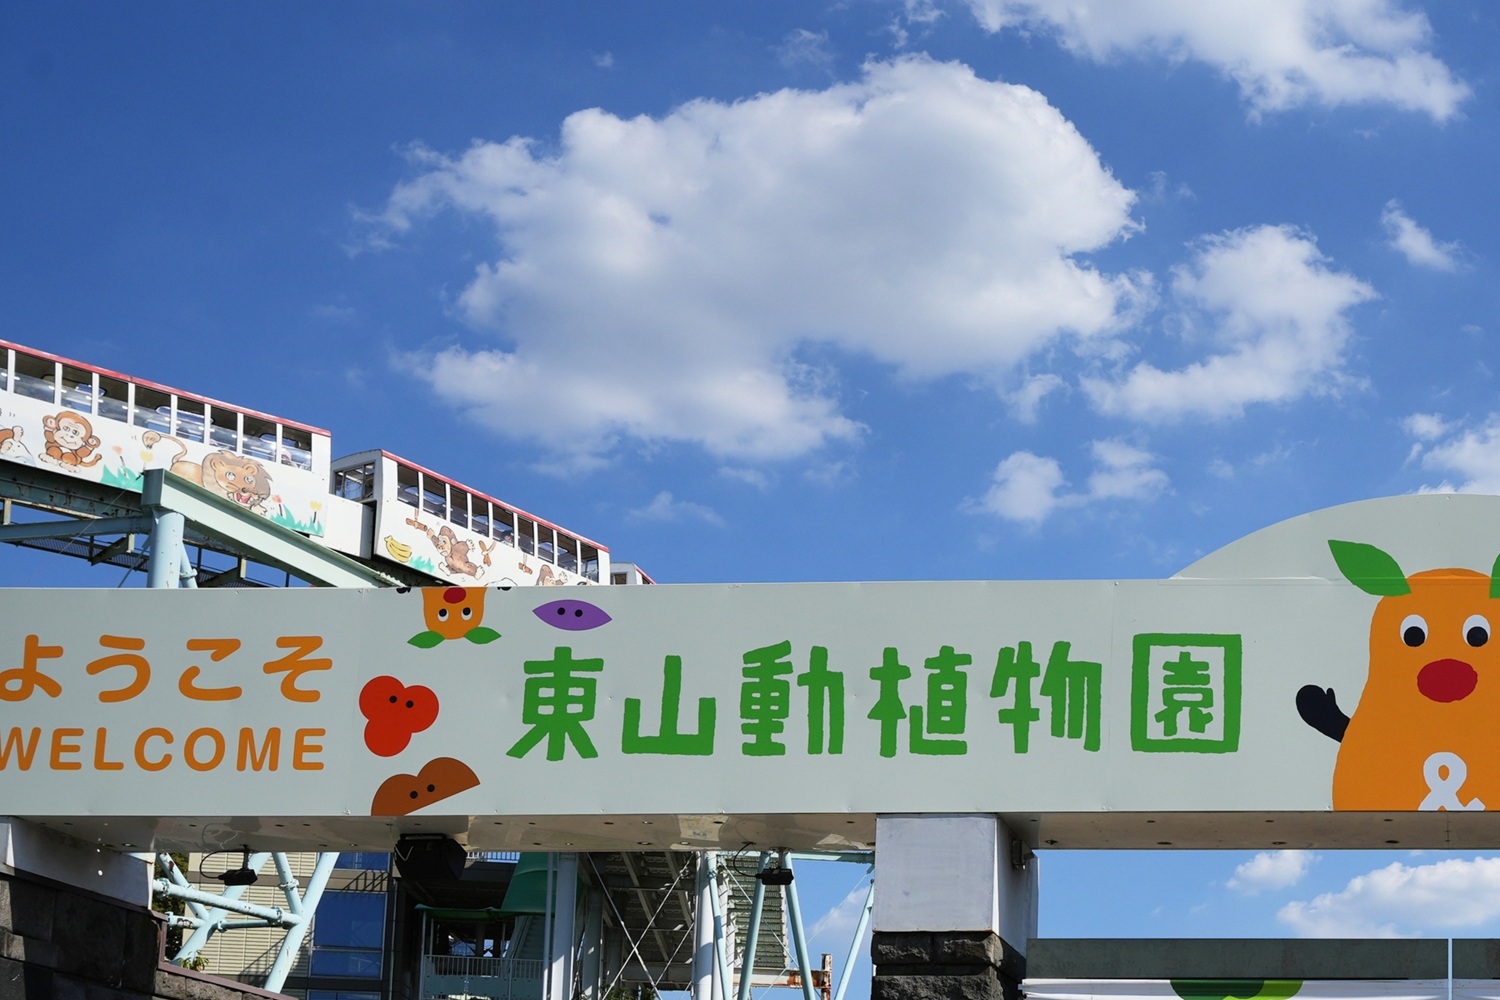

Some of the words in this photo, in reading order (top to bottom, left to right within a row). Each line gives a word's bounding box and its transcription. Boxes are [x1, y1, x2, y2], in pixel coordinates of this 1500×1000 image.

[0, 634, 332, 702] ようこそ
[505, 633, 1242, 762] 東山動植物園
[0, 727, 326, 771] WELCOME
